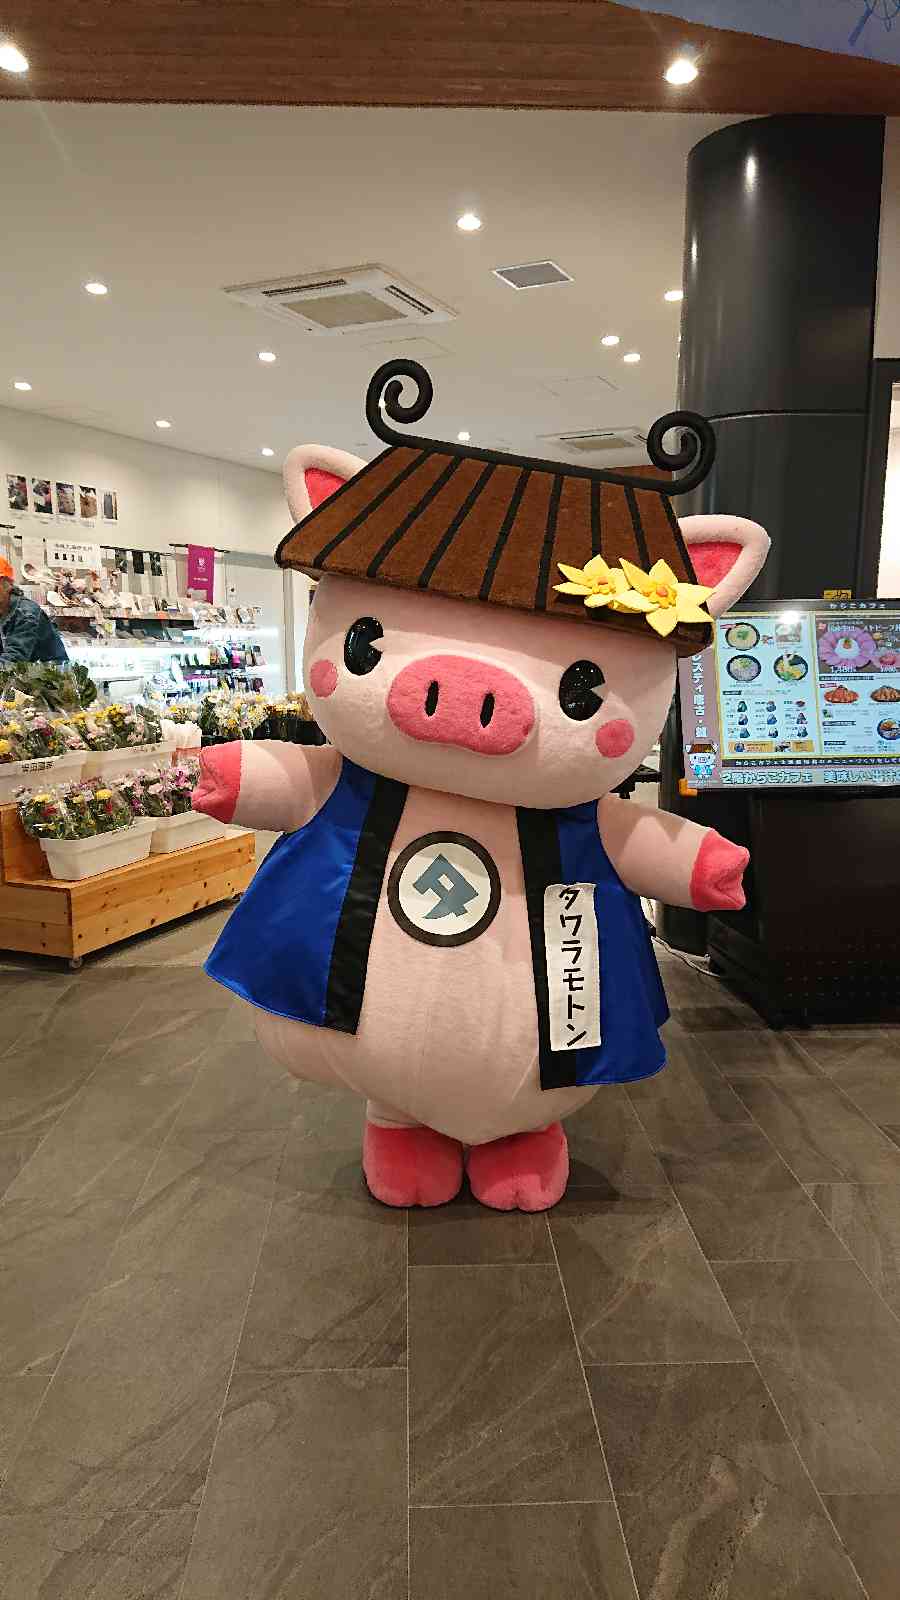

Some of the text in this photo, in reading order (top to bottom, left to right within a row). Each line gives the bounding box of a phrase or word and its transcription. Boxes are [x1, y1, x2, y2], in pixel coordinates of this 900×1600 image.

[721, 770, 813, 785] 2階からこカフェ
[558, 887, 587, 1048] タワラモトン
